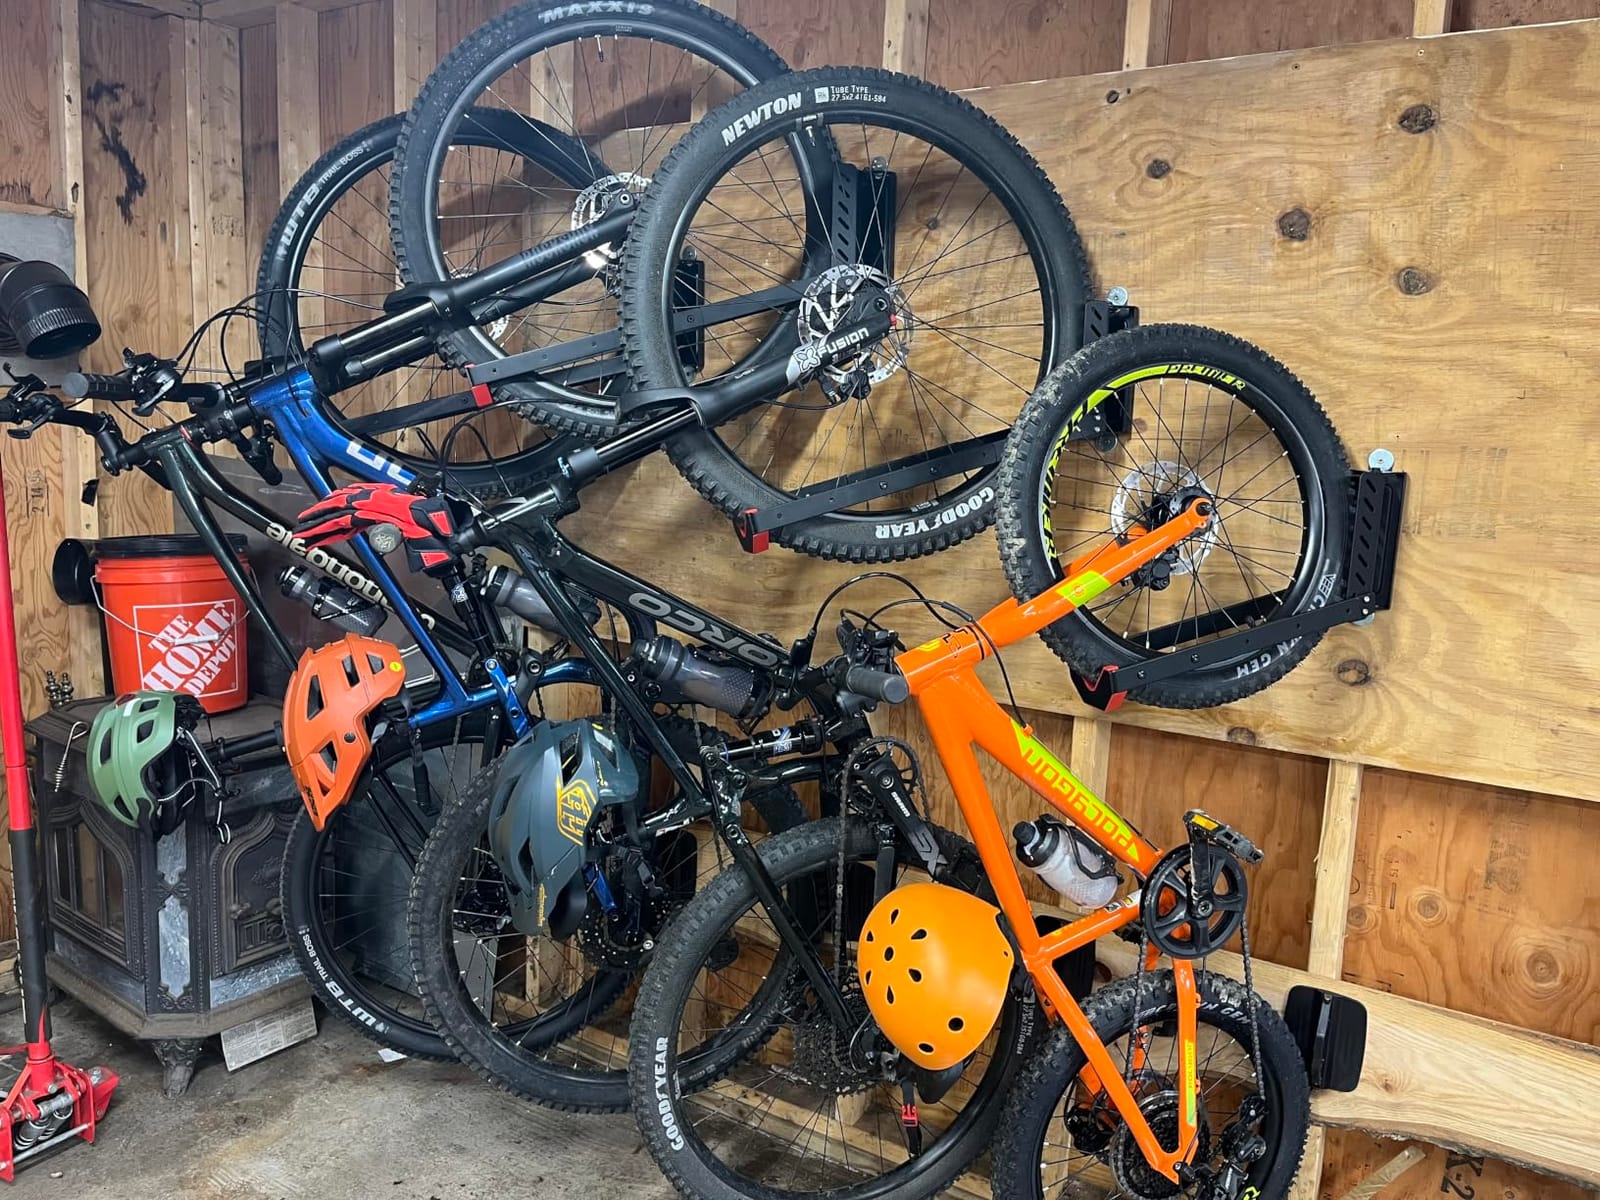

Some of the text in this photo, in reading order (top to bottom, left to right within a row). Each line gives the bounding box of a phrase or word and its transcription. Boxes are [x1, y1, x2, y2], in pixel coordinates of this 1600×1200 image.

[540, 1, 655, 24] MAXXIS
[851, 85, 869, 94] TYPE
[721, 92, 801, 146] NEWTON
[280, 145, 364, 246] WTB TRAIL BOSS
[875, 486, 995, 539] GOODYEAR
[143, 601, 235, 691] HOME
[148, 614, 193, 653] THE
[629, 592, 779, 667] ORCO
[183, 634, 236, 695] DEPOT
[1236, 653, 1272, 678] GEM
[302, 934, 377, 1027] WTB TRAIL BOSS
[654, 1036, 685, 1151] GOODYEAR
